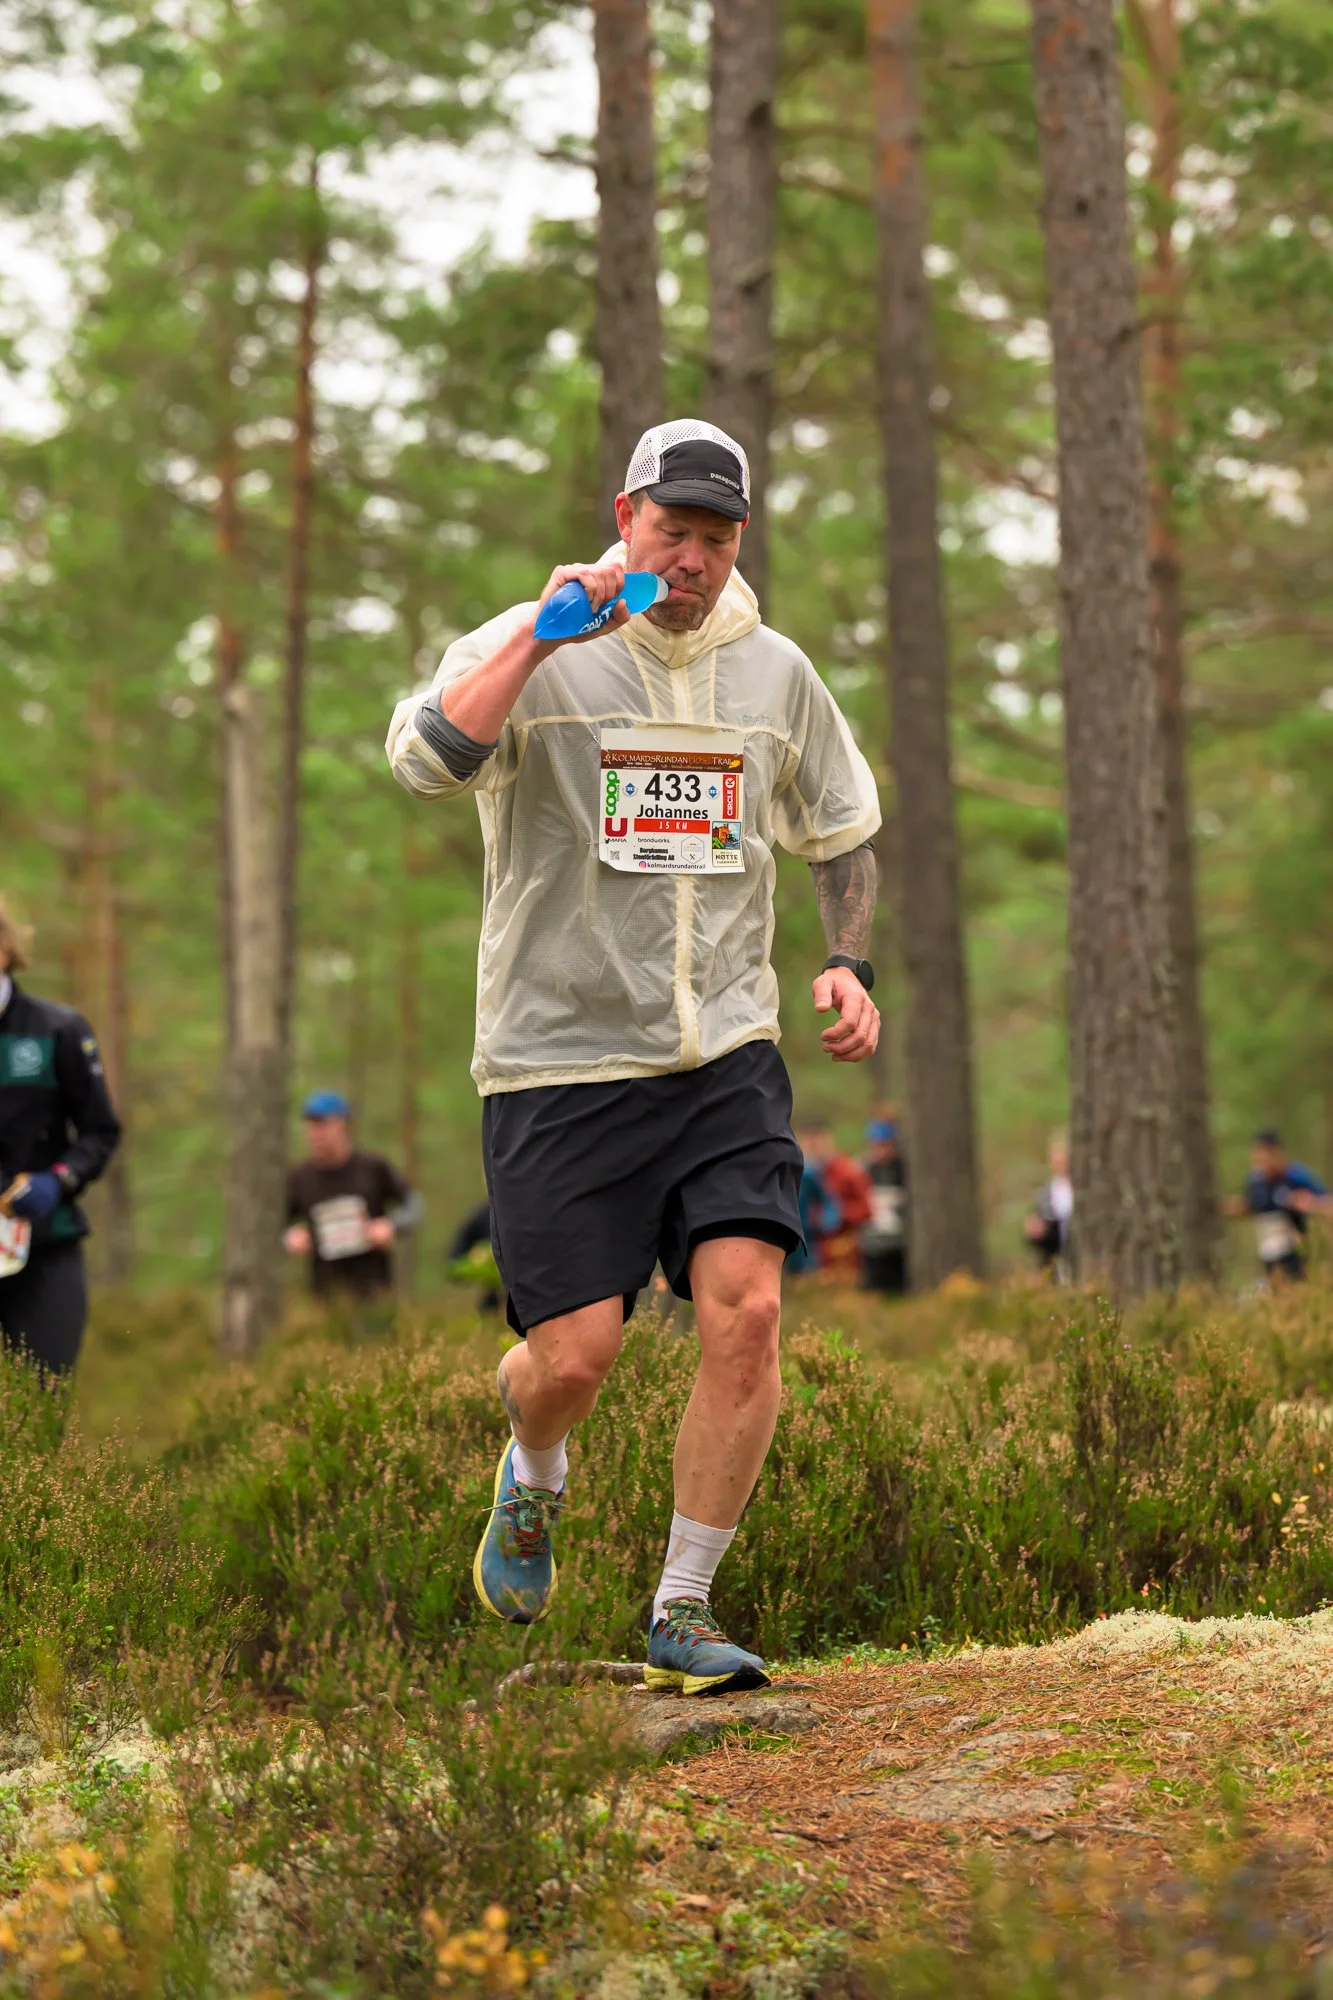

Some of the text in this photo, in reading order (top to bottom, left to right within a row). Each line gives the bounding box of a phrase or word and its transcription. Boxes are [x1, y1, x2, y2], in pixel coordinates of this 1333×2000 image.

[606, 770, 620, 816] coop
[645, 773, 701, 802] 433
[636, 804, 709, 820] Johannes
[726, 790, 734, 816] CIRCLE
[659, 821, 688, 830] 15 KM
